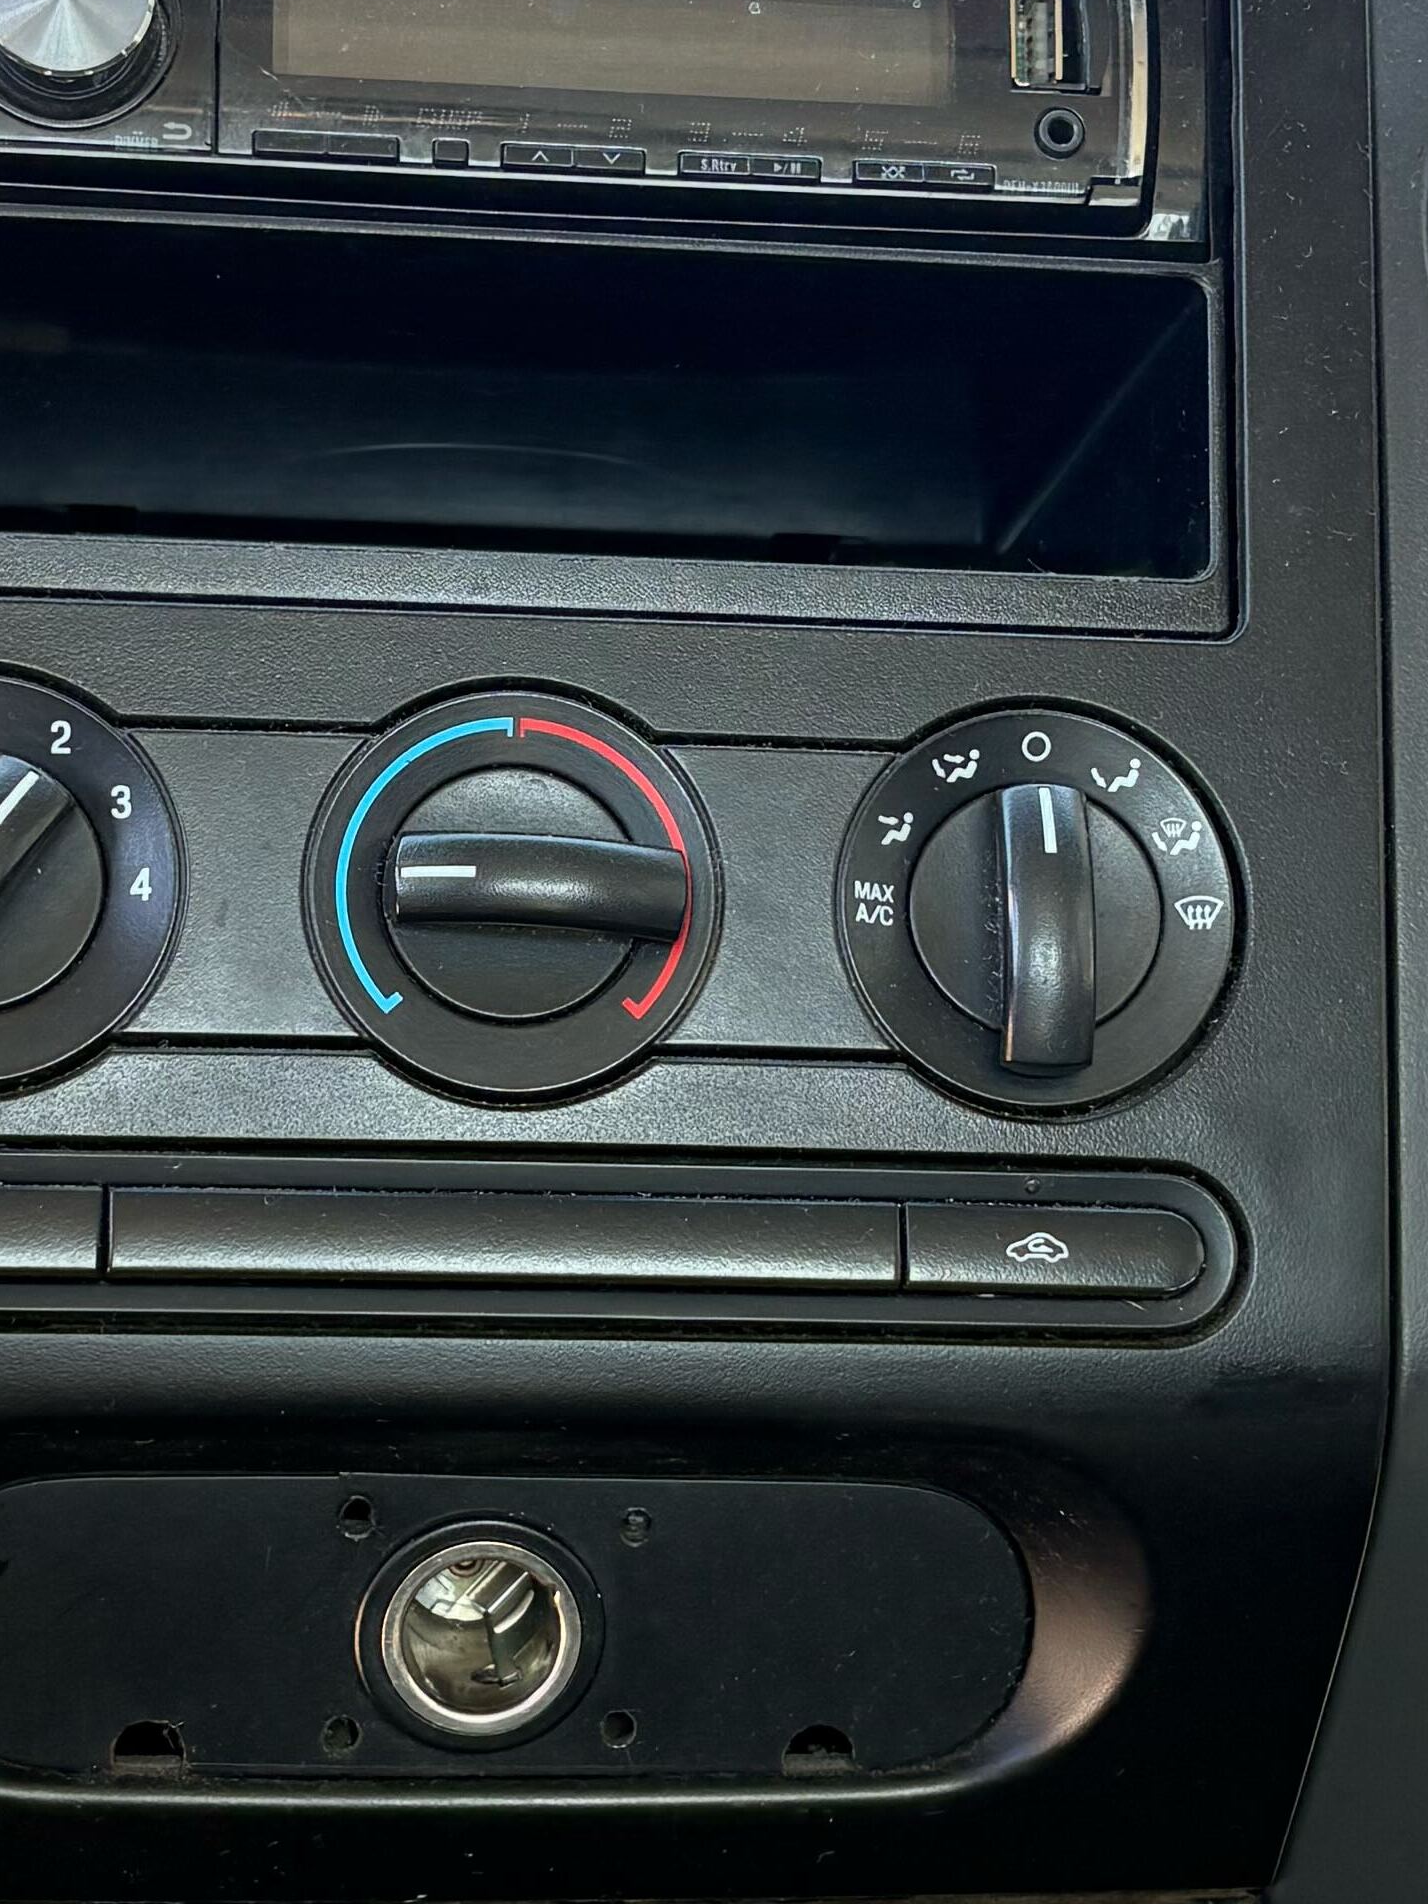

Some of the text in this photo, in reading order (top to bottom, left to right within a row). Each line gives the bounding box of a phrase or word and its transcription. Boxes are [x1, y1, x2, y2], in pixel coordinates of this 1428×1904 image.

[50, 720, 72, 755] 2
[110, 785, 133, 820] 3
[129, 867, 153, 902] 4
[854, 880, 895, 904] MAX
[855, 902, 894, 926] A/C
